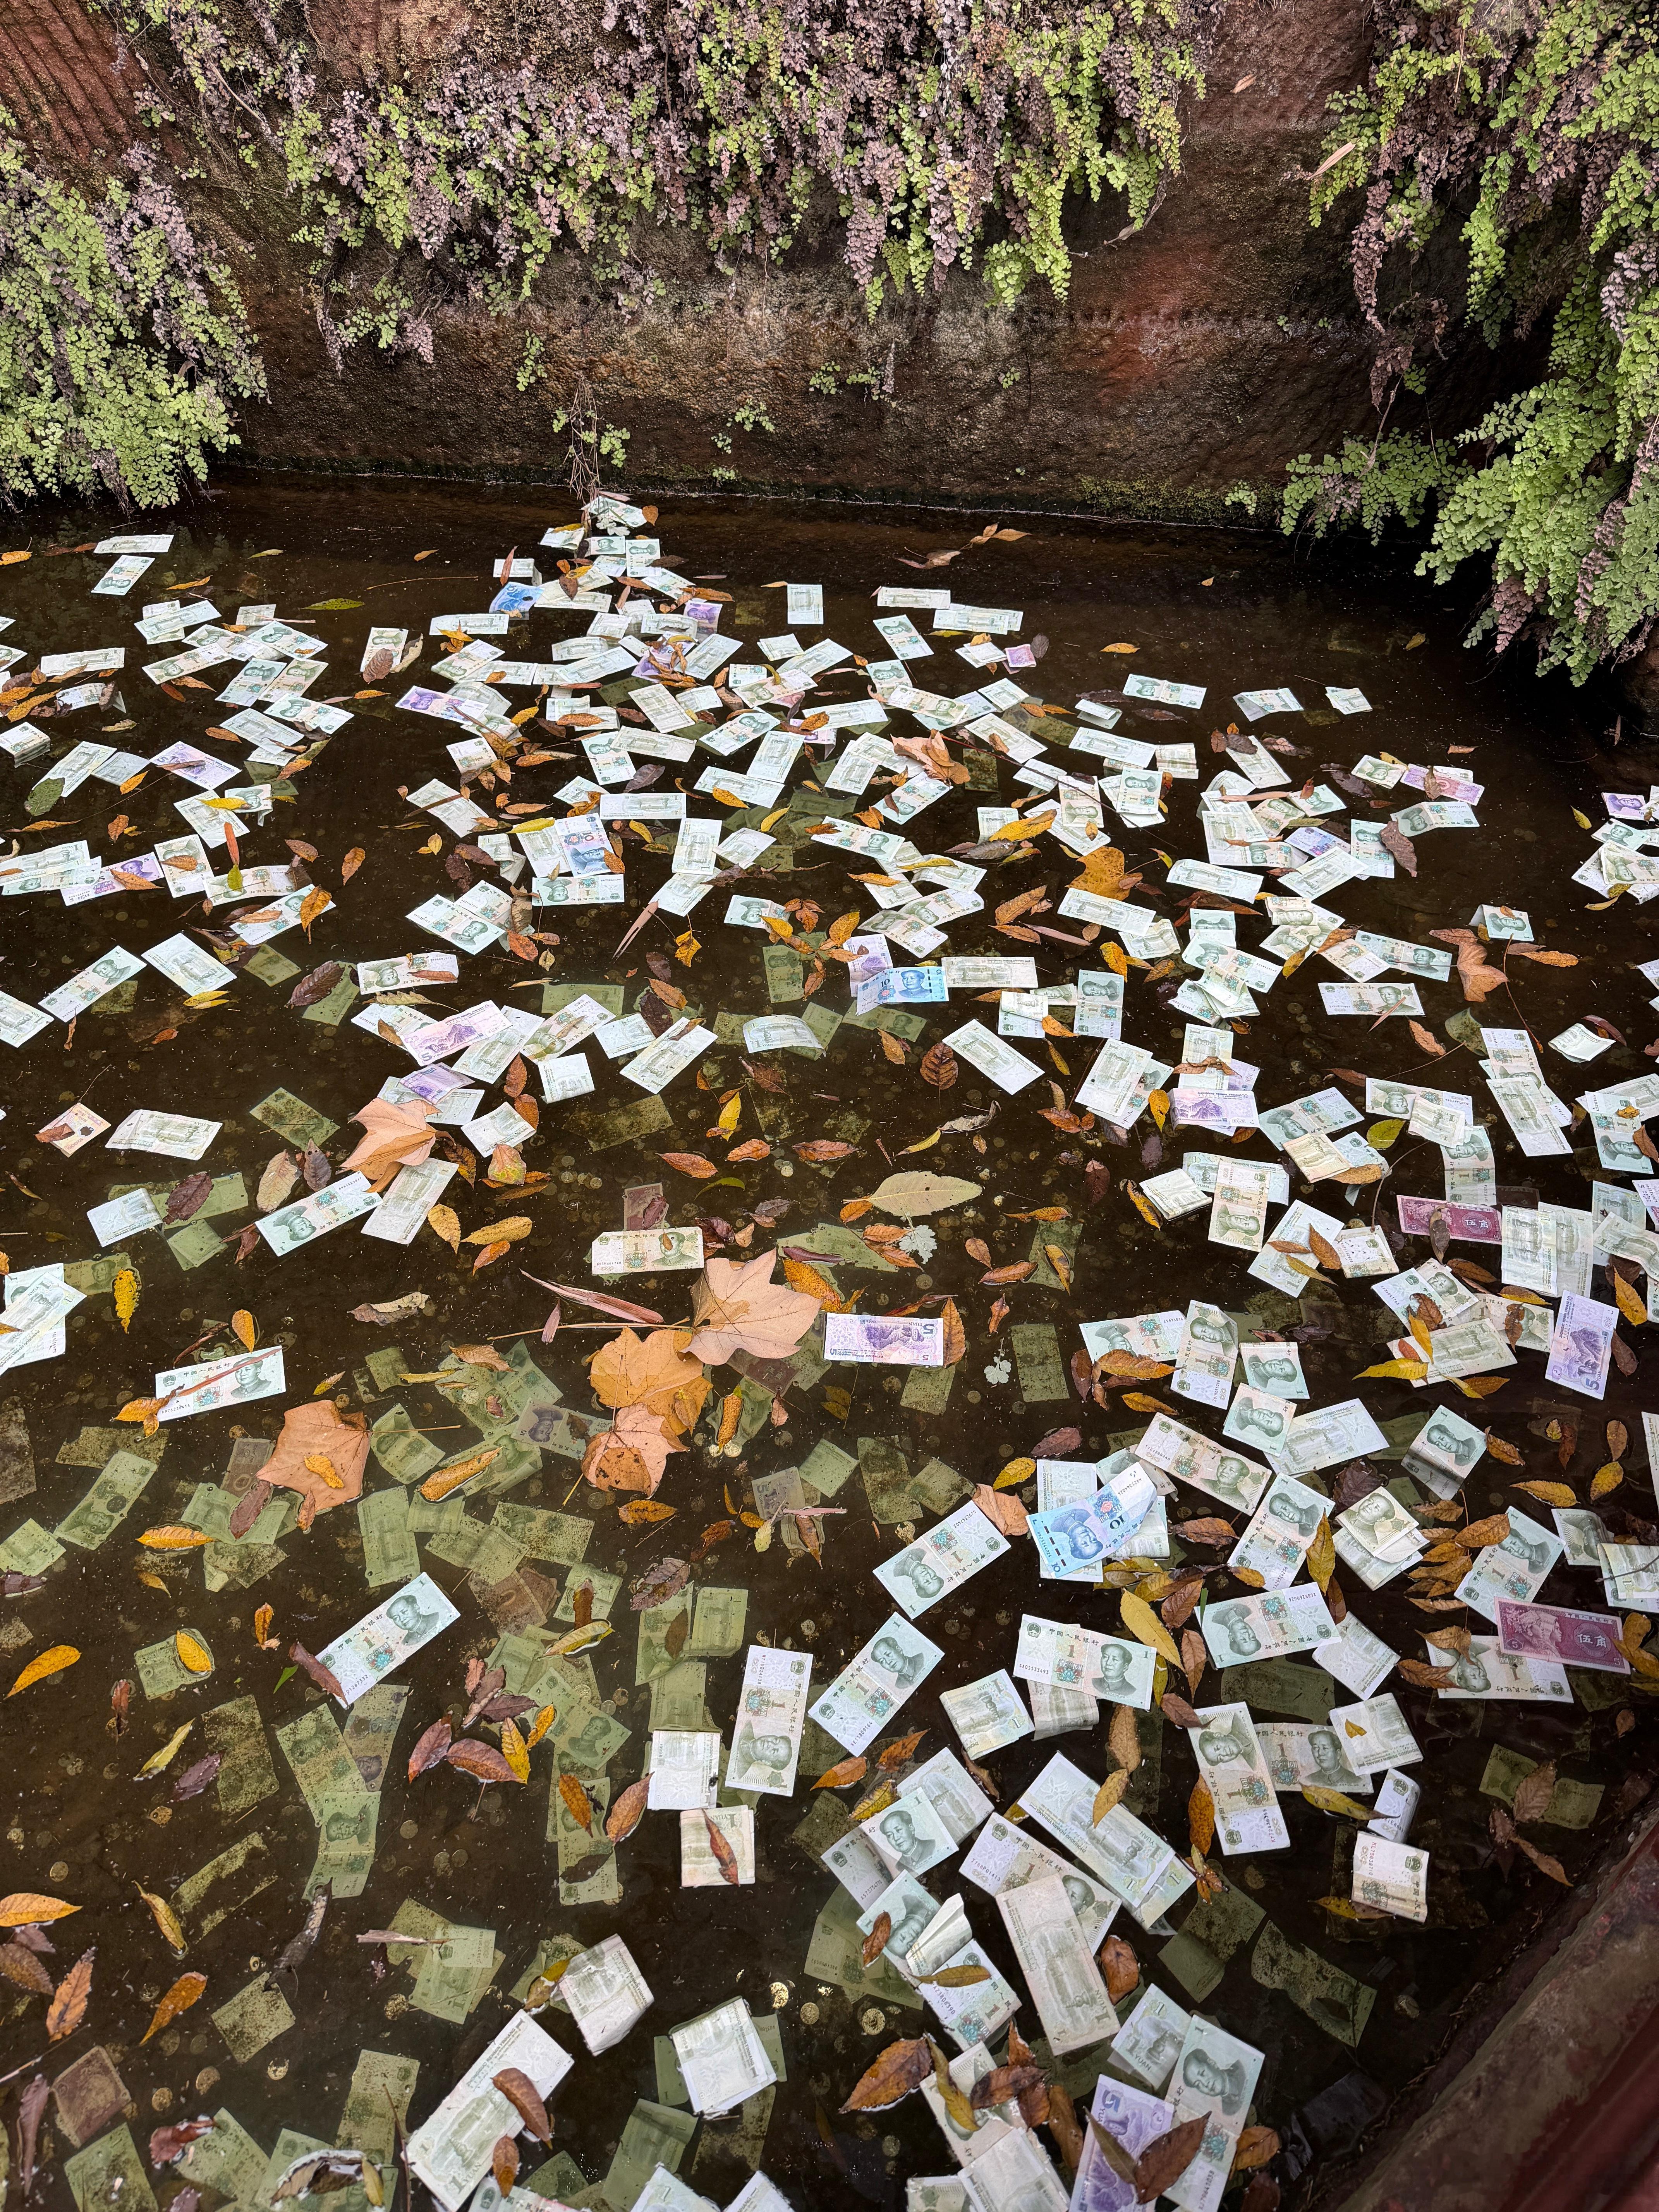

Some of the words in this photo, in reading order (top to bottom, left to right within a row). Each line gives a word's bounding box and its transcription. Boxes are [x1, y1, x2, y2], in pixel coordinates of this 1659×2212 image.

[582, 831, 594, 841] 10
[881, 979, 890, 987] 10
[421, 1052, 432, 1061] 5
[329, 1207, 339, 1216] 1
[1465, 1219, 1489, 1228] 伍角
[27, 1287, 39, 1297] YUAN
[1479, 1307, 1486, 1317] 1
[923, 1324, 934, 1334] 5
[1478, 1323, 1488, 1333] 1
[1152, 1339, 1162, 1349] 1
[1195, 1357, 1207, 1365] 1
[1586, 1378, 1599, 1390] 5
[1191, 1447, 1199, 1458] 1
[757, 1484, 769, 1493] 5
[1109, 1516, 1126, 1530] 10
[1263, 1534, 1277, 1545] 1
[951, 1551, 963, 1563] 1
[1051, 1562, 1061, 1572] 10
[1492, 1568, 1504, 1578] 1
[1278, 1623, 1288, 1635] 1
[363, 1636, 375, 1649] 1
[1578, 1633, 1606, 1647] 伍角
[1068, 1644, 1075, 1658] 1
[1143, 1650, 1148, 1659] 1
[1510, 1668, 1520, 1680] 1
[856, 1682, 869, 1695] 1
[977, 1681, 992, 1691] YUAN
[991, 1678, 1005, 1693] 1
[771, 1700, 785, 1709] 1
[1011, 1717, 1021, 1728] 1
[1279, 1744, 1286, 1757] 1
[1227, 1790, 1242, 1799] 1
[913, 1796, 922, 1805] 1
[728, 1814, 737, 1827] 1
[1139, 1831, 1154, 1846] YUAN
[865, 1843, 877, 1857] 1
[1149, 1843, 1162, 1858] 1
[1024, 1863, 1036, 1879] 1
[1169, 1871, 1181, 1885] 1
[1126, 1878, 1136, 1891] 1
[1004, 1899, 1011, 1908] 1
[1095, 1990, 1107, 2012] YUAN
[986, 2004, 1000, 2019] 1
[516, 2018, 525, 2028] 1
[1096, 2013, 1111, 2023] 1
[1134, 2054, 1151, 2071] YUAN
[750, 2067, 759, 2078] 1
[1102, 2090, 1121, 2113] 5
[463, 2162, 482, 2184] YUAN
[449, 2176, 463, 2193] 1
[661, 2186, 672, 2202] 1
